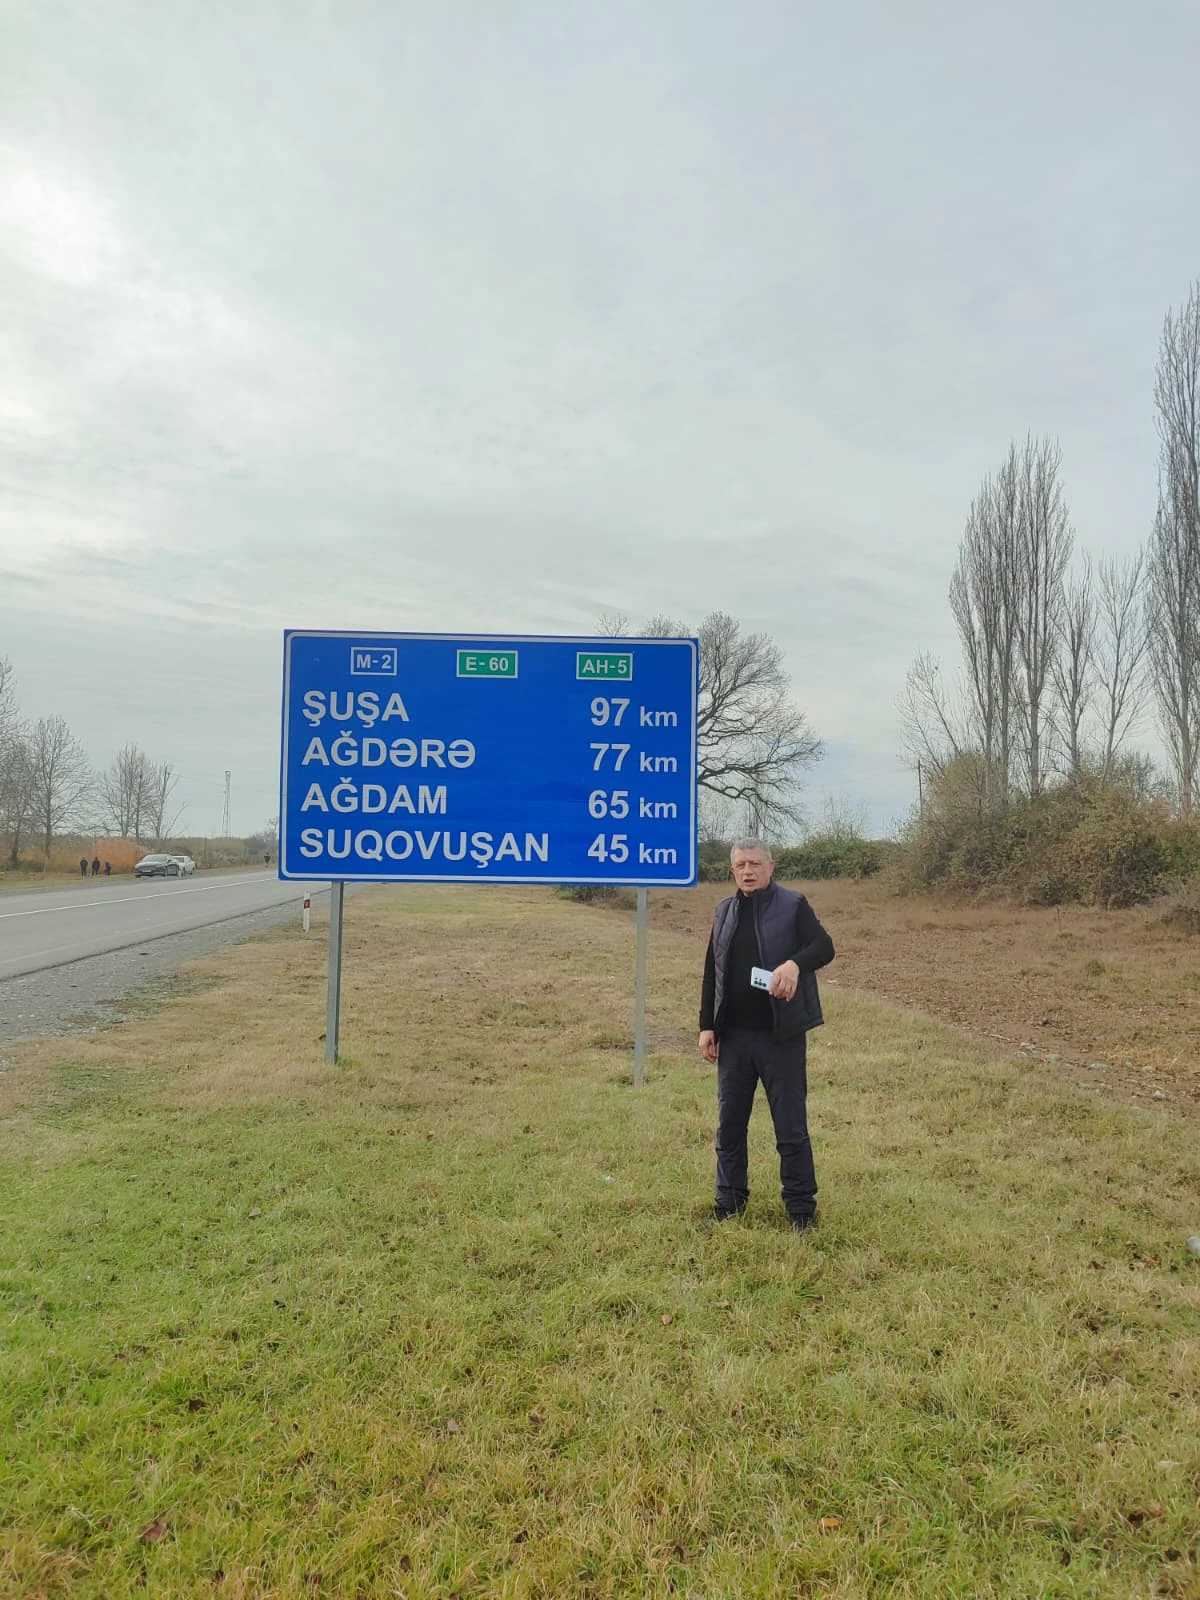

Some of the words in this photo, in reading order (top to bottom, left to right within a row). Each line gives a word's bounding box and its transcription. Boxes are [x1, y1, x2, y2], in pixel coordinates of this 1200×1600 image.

[356, 654, 391, 669] M-2
[465, 656, 509, 671] E-60
[582, 659, 627, 674] AH-5
[302, 690, 409, 728] ŞUŞA
[590, 697, 630, 727] 97
[639, 706, 678, 727] km
[301, 730, 476, 769] AĞDƏRƏ
[589, 743, 631, 772] 77
[639, 751, 677, 773] km
[300, 777, 447, 814] AĞDAM
[588, 789, 629, 819] 65
[639, 797, 677, 819] km
[299, 828, 549, 869] SUQOVUŞAN
[587, 833, 629, 863] 45
[639, 842, 677, 865] km
